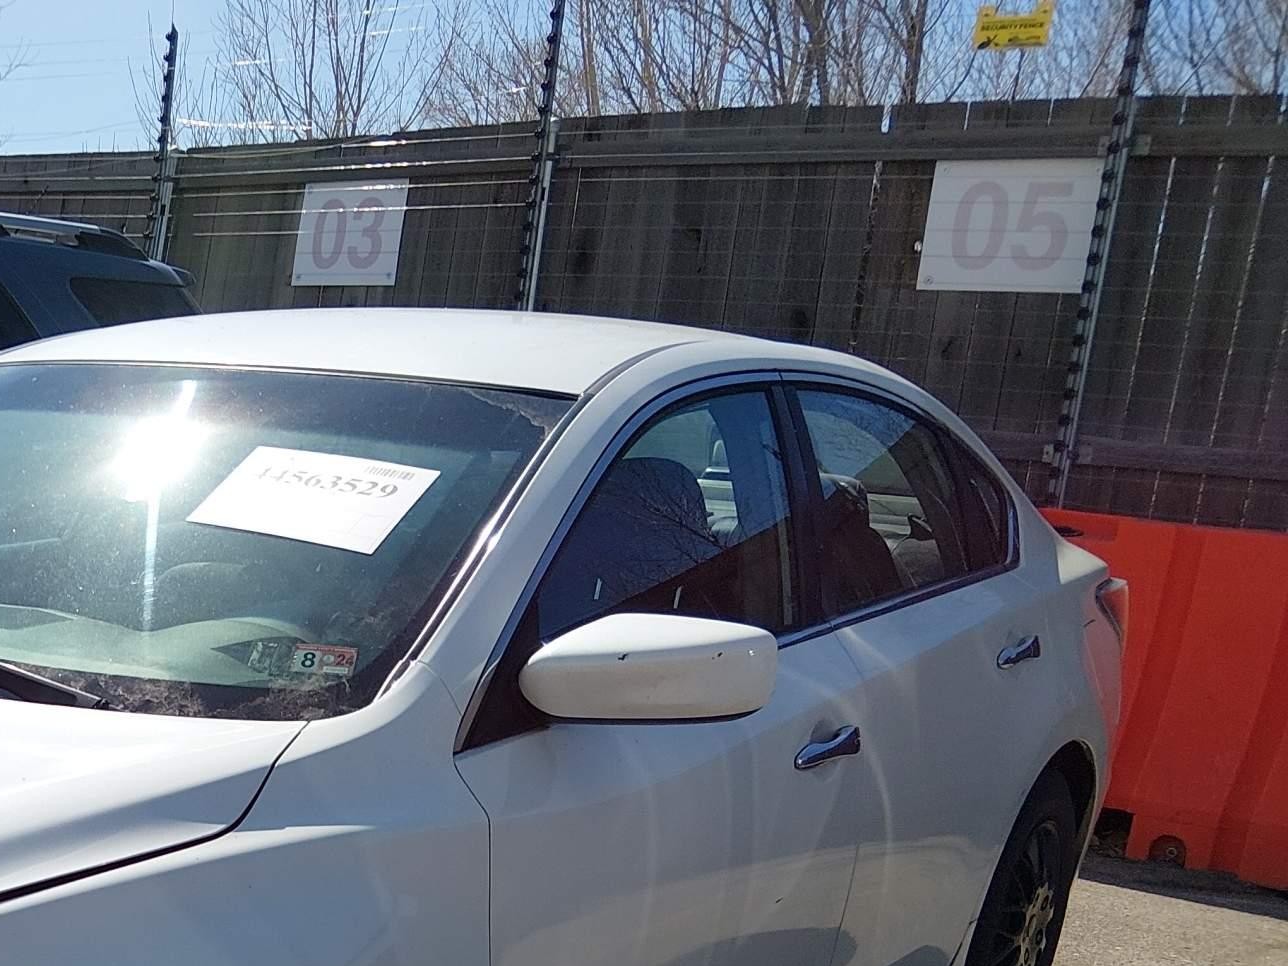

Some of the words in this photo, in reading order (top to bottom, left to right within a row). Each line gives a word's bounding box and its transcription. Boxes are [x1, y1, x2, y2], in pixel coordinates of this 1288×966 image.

[313, 196, 385, 270] 03
[951, 181, 1074, 271] 05
[300, 651, 316, 668] 8
